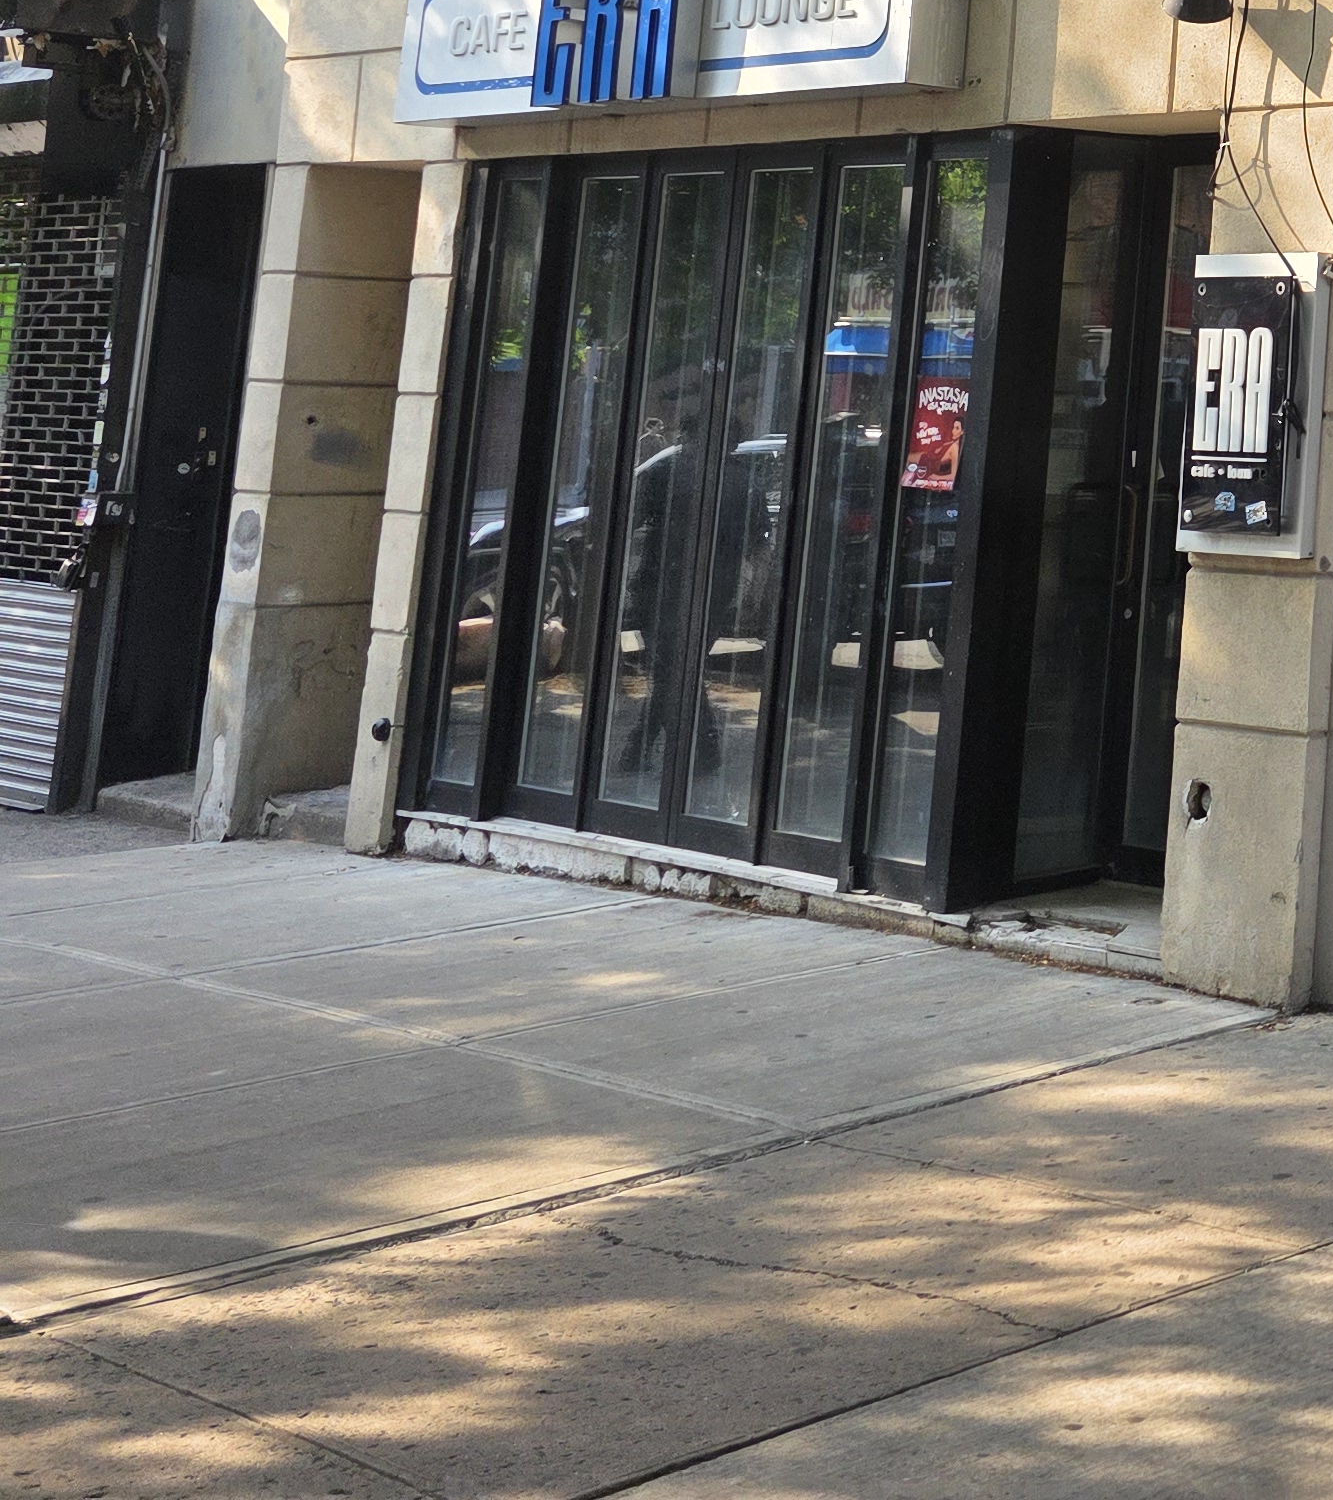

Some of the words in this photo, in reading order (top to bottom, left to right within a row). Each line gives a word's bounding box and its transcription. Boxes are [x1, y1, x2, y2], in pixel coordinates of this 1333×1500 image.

[448, 10, 529, 58] CAFE
[918, 386, 970, 412] ANASTASIA
[1192, 326, 1273, 454] ERA
[1190, 463, 1216, 478] cafe
